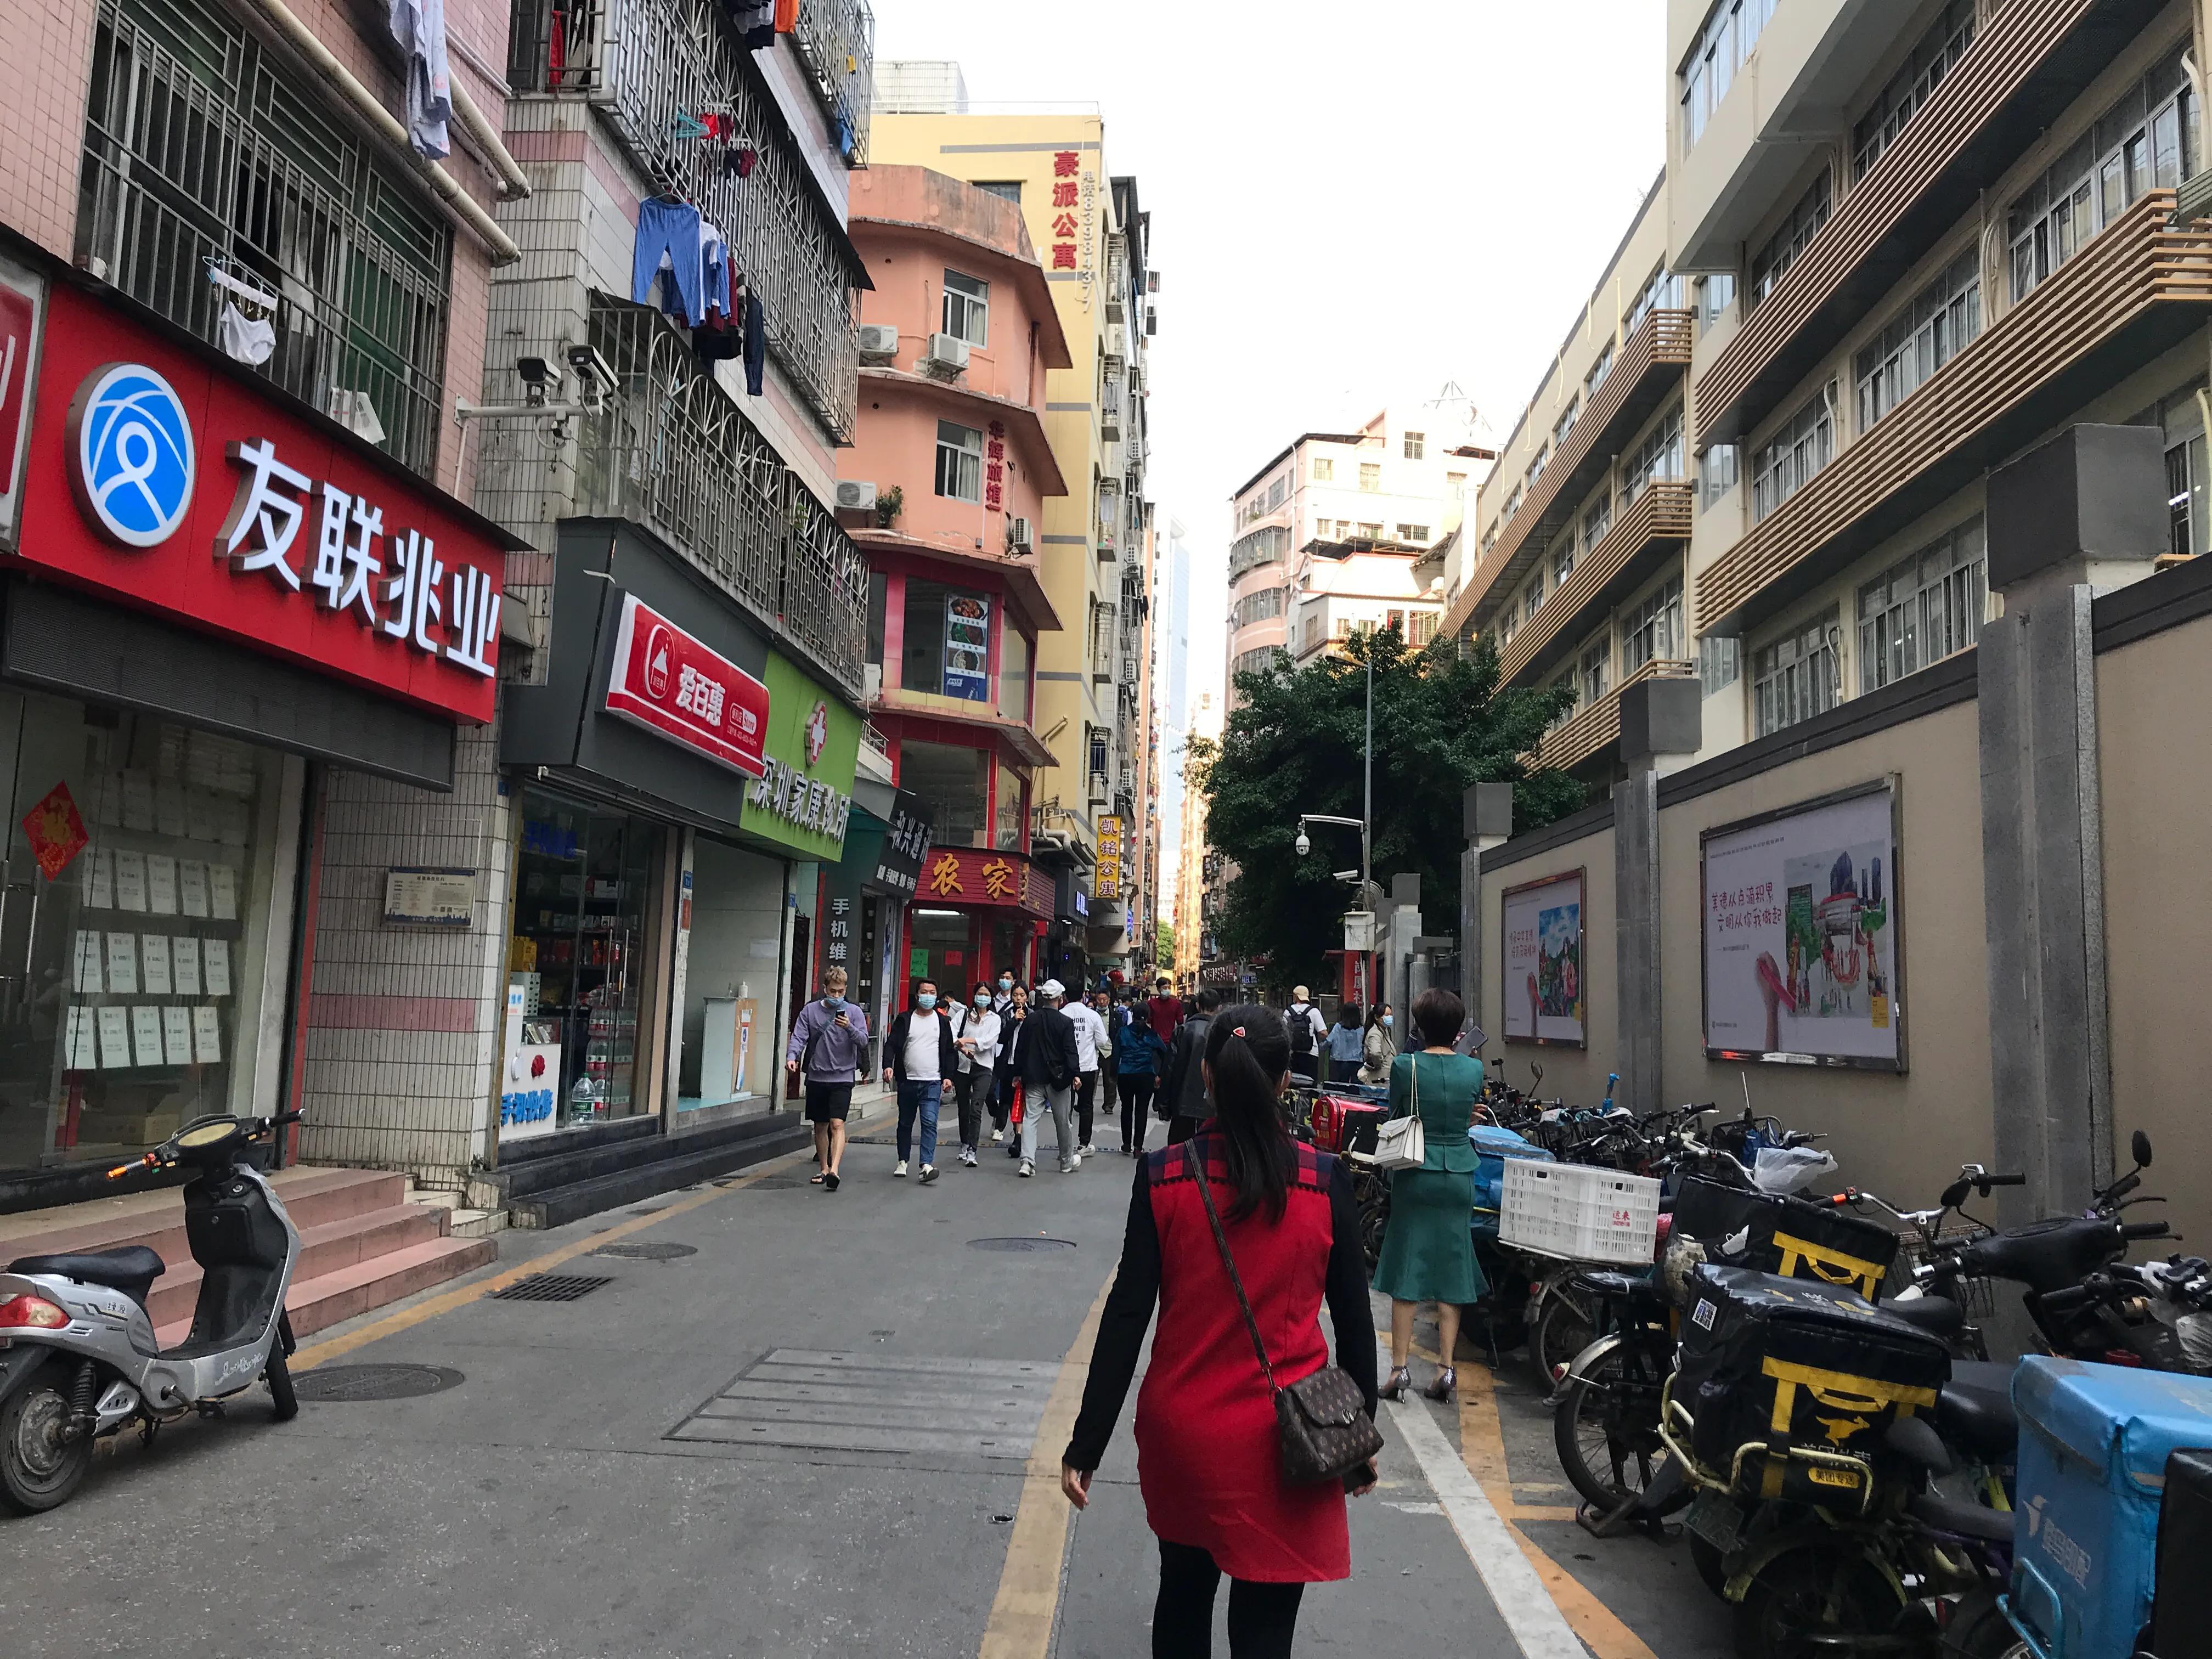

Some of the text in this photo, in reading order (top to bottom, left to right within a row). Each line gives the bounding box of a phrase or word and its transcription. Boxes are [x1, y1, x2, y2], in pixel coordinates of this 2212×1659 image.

[1052, 151, 1080, 269] 豪派公寓
[986, 420, 1005, 505] 华辉旅馆
[226, 438, 500, 678] 友联兆业
[675, 663, 726, 727] 爱百惠
[754, 753, 851, 843] 深圳家康诊所
[930, 853, 1016, 900] 农家
[1098, 819, 1118, 896] 凯铭公寓
[1712, 882, 1774, 912] 美德从点滴积累
[1717, 905, 1782, 933] 文明从你我做起
[1816, 1468, 1854, 1485] 美团专送
